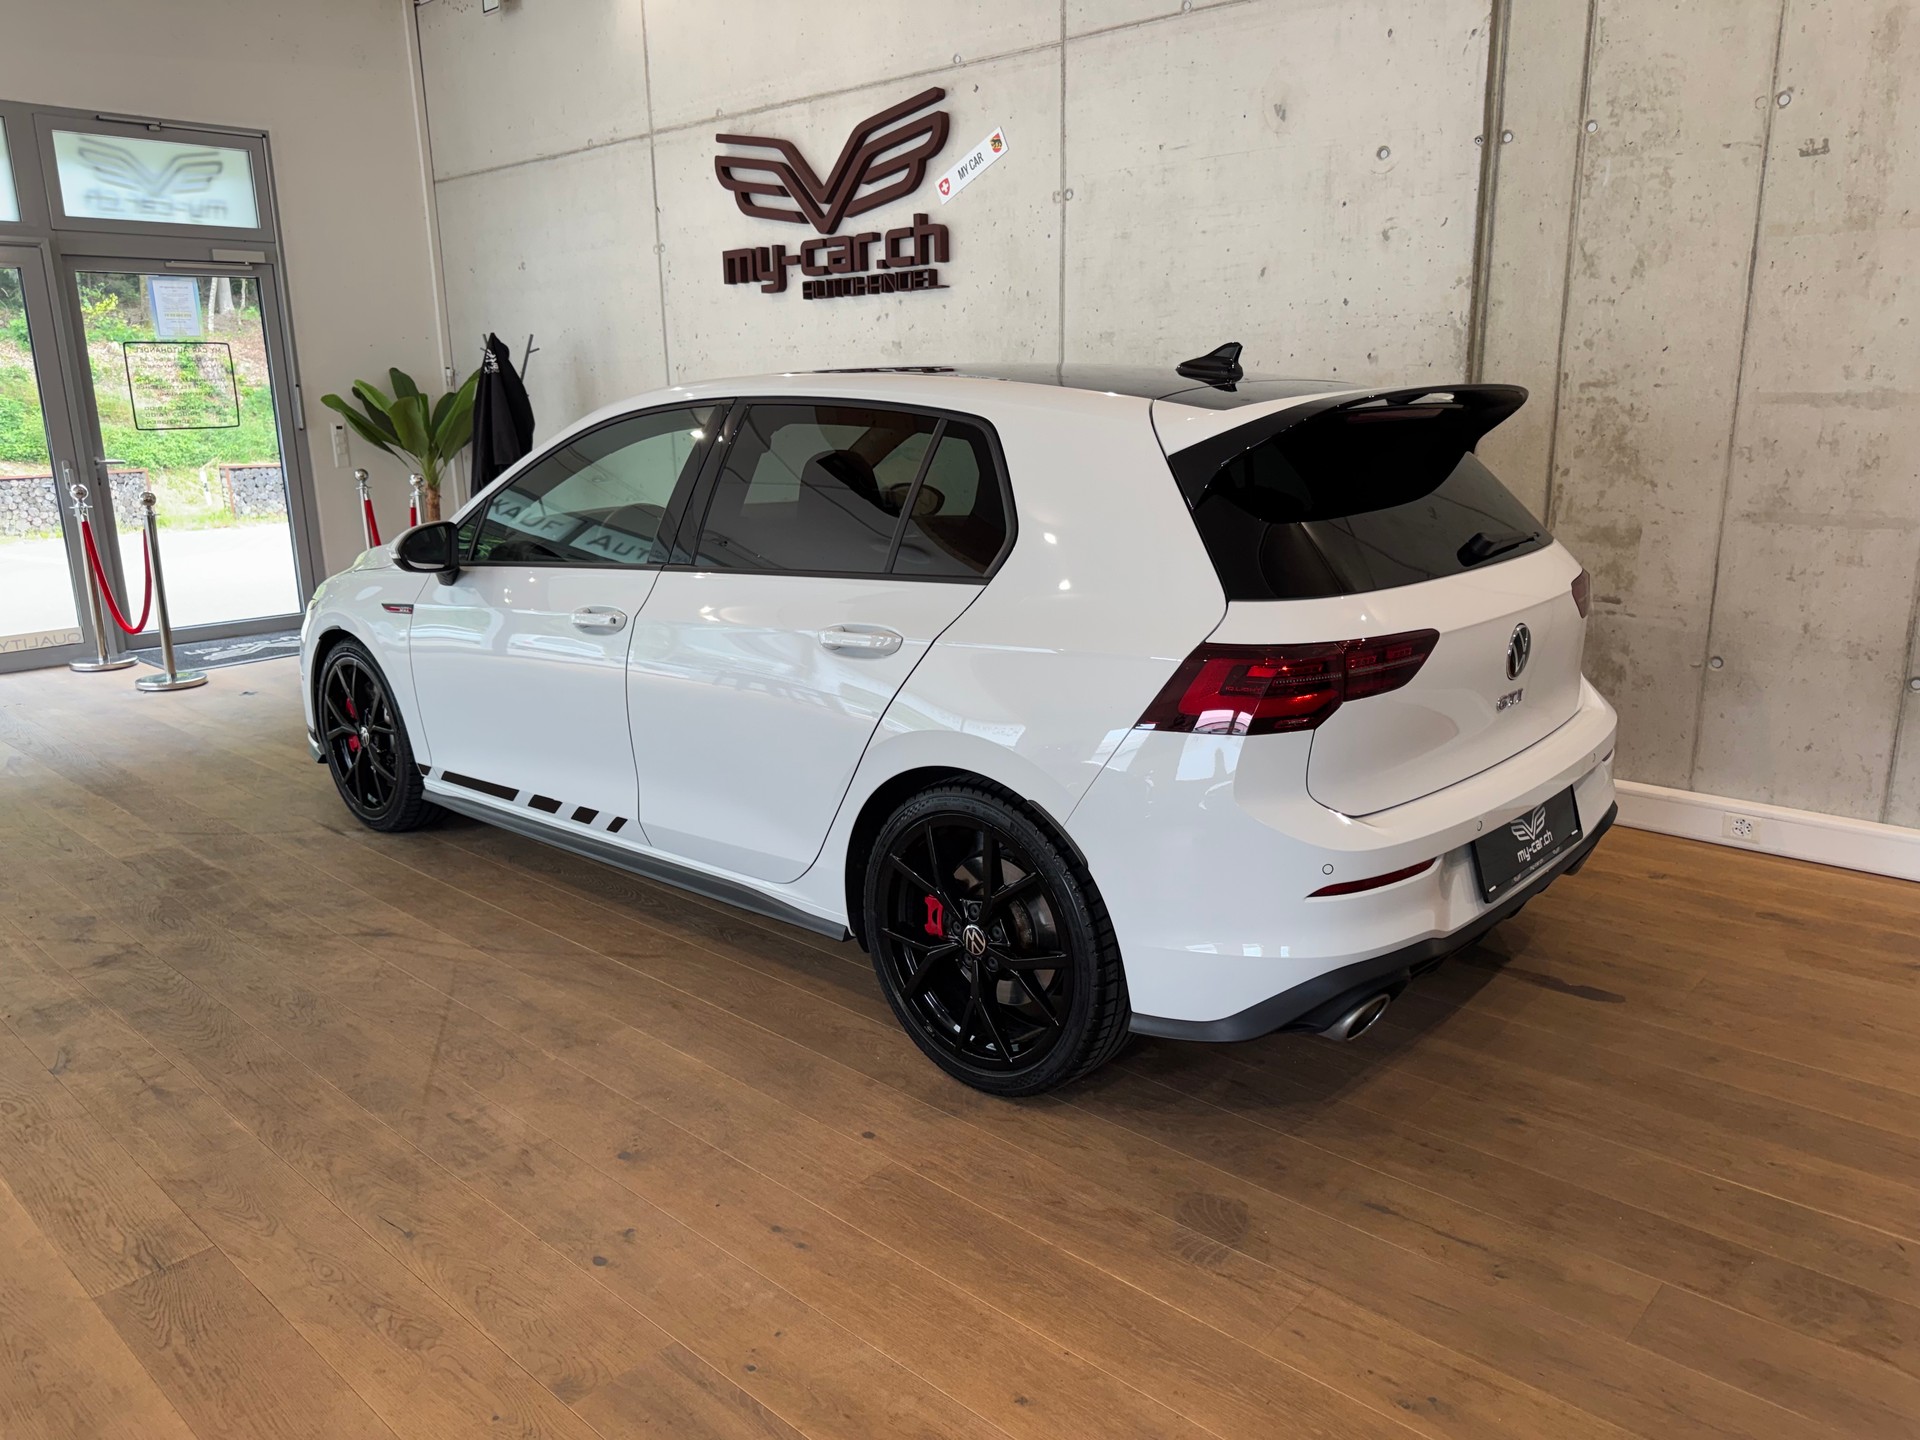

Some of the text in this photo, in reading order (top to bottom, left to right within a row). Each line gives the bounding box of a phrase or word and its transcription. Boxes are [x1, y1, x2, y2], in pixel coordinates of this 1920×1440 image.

[957, 151, 985, 180] MY CAR
[722, 213, 950, 294] my-car.ch
[1496, 688, 1523, 712] GTI
[1517, 829, 1554, 863] my-car.ch
